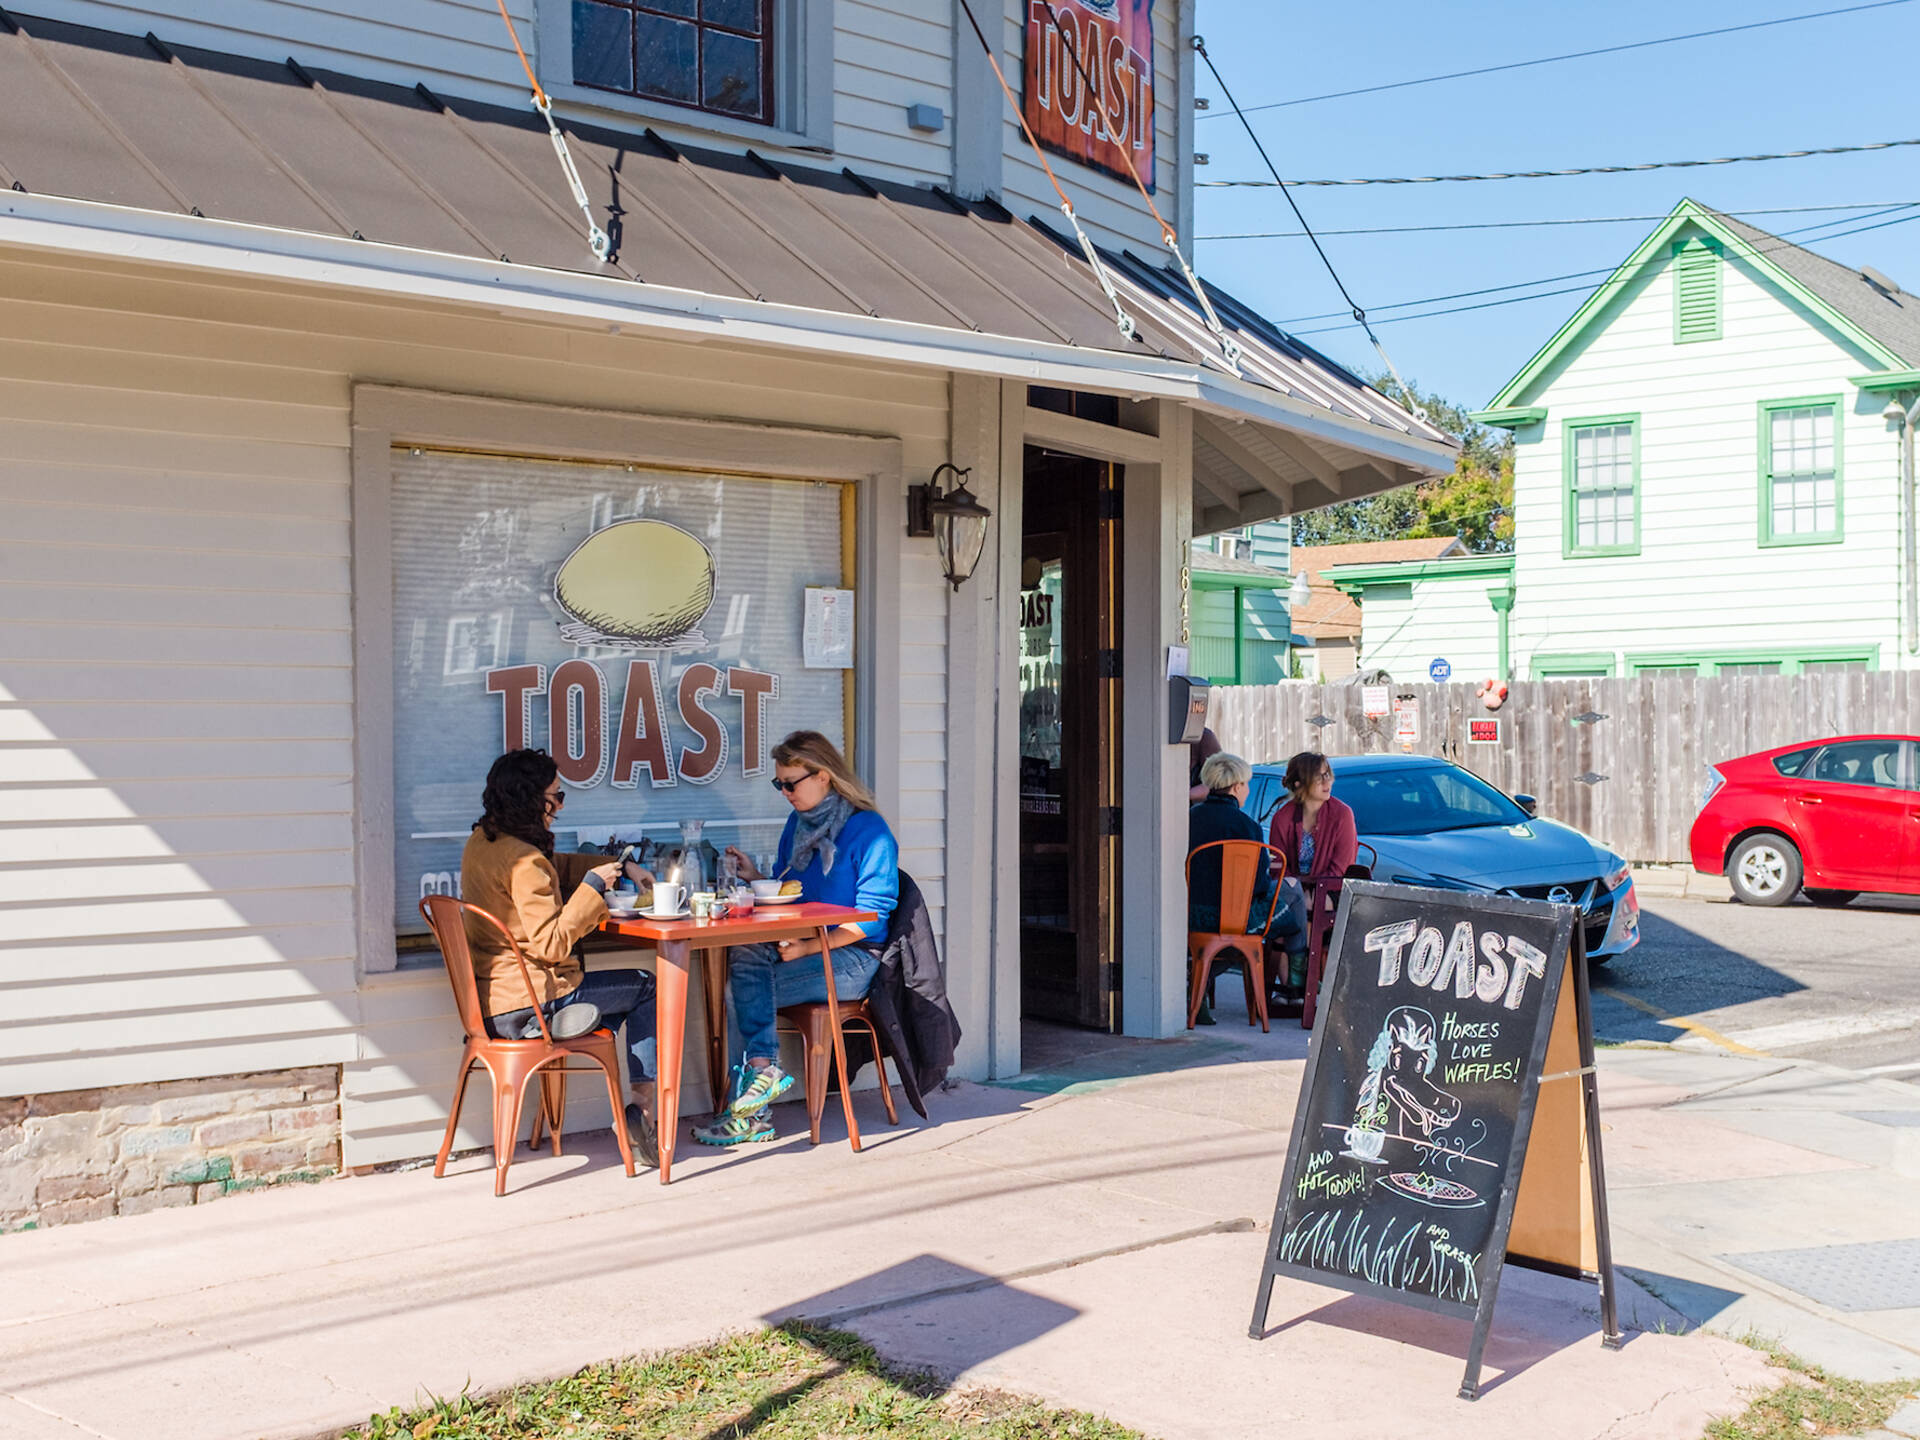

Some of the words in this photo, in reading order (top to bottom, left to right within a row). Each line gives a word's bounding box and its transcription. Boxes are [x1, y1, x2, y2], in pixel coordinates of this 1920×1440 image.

[1031, 1, 1151, 150] TOAST
[1180, 540, 1191, 644] 1845
[1021, 592, 1054, 628] OAST
[1432, 665, 1449, 676] ADT
[485, 659, 780, 789] TOAST
[1479, 733, 1497, 741] DOG
[1364, 919, 1547, 1010] TOAST
[1451, 1042, 1493, 1060] LOVE
[1444, 1058, 1521, 1084] WAFFLES!
[1307, 1150, 1334, 1173] AND
[1426, 1224, 1450, 1240] AND
